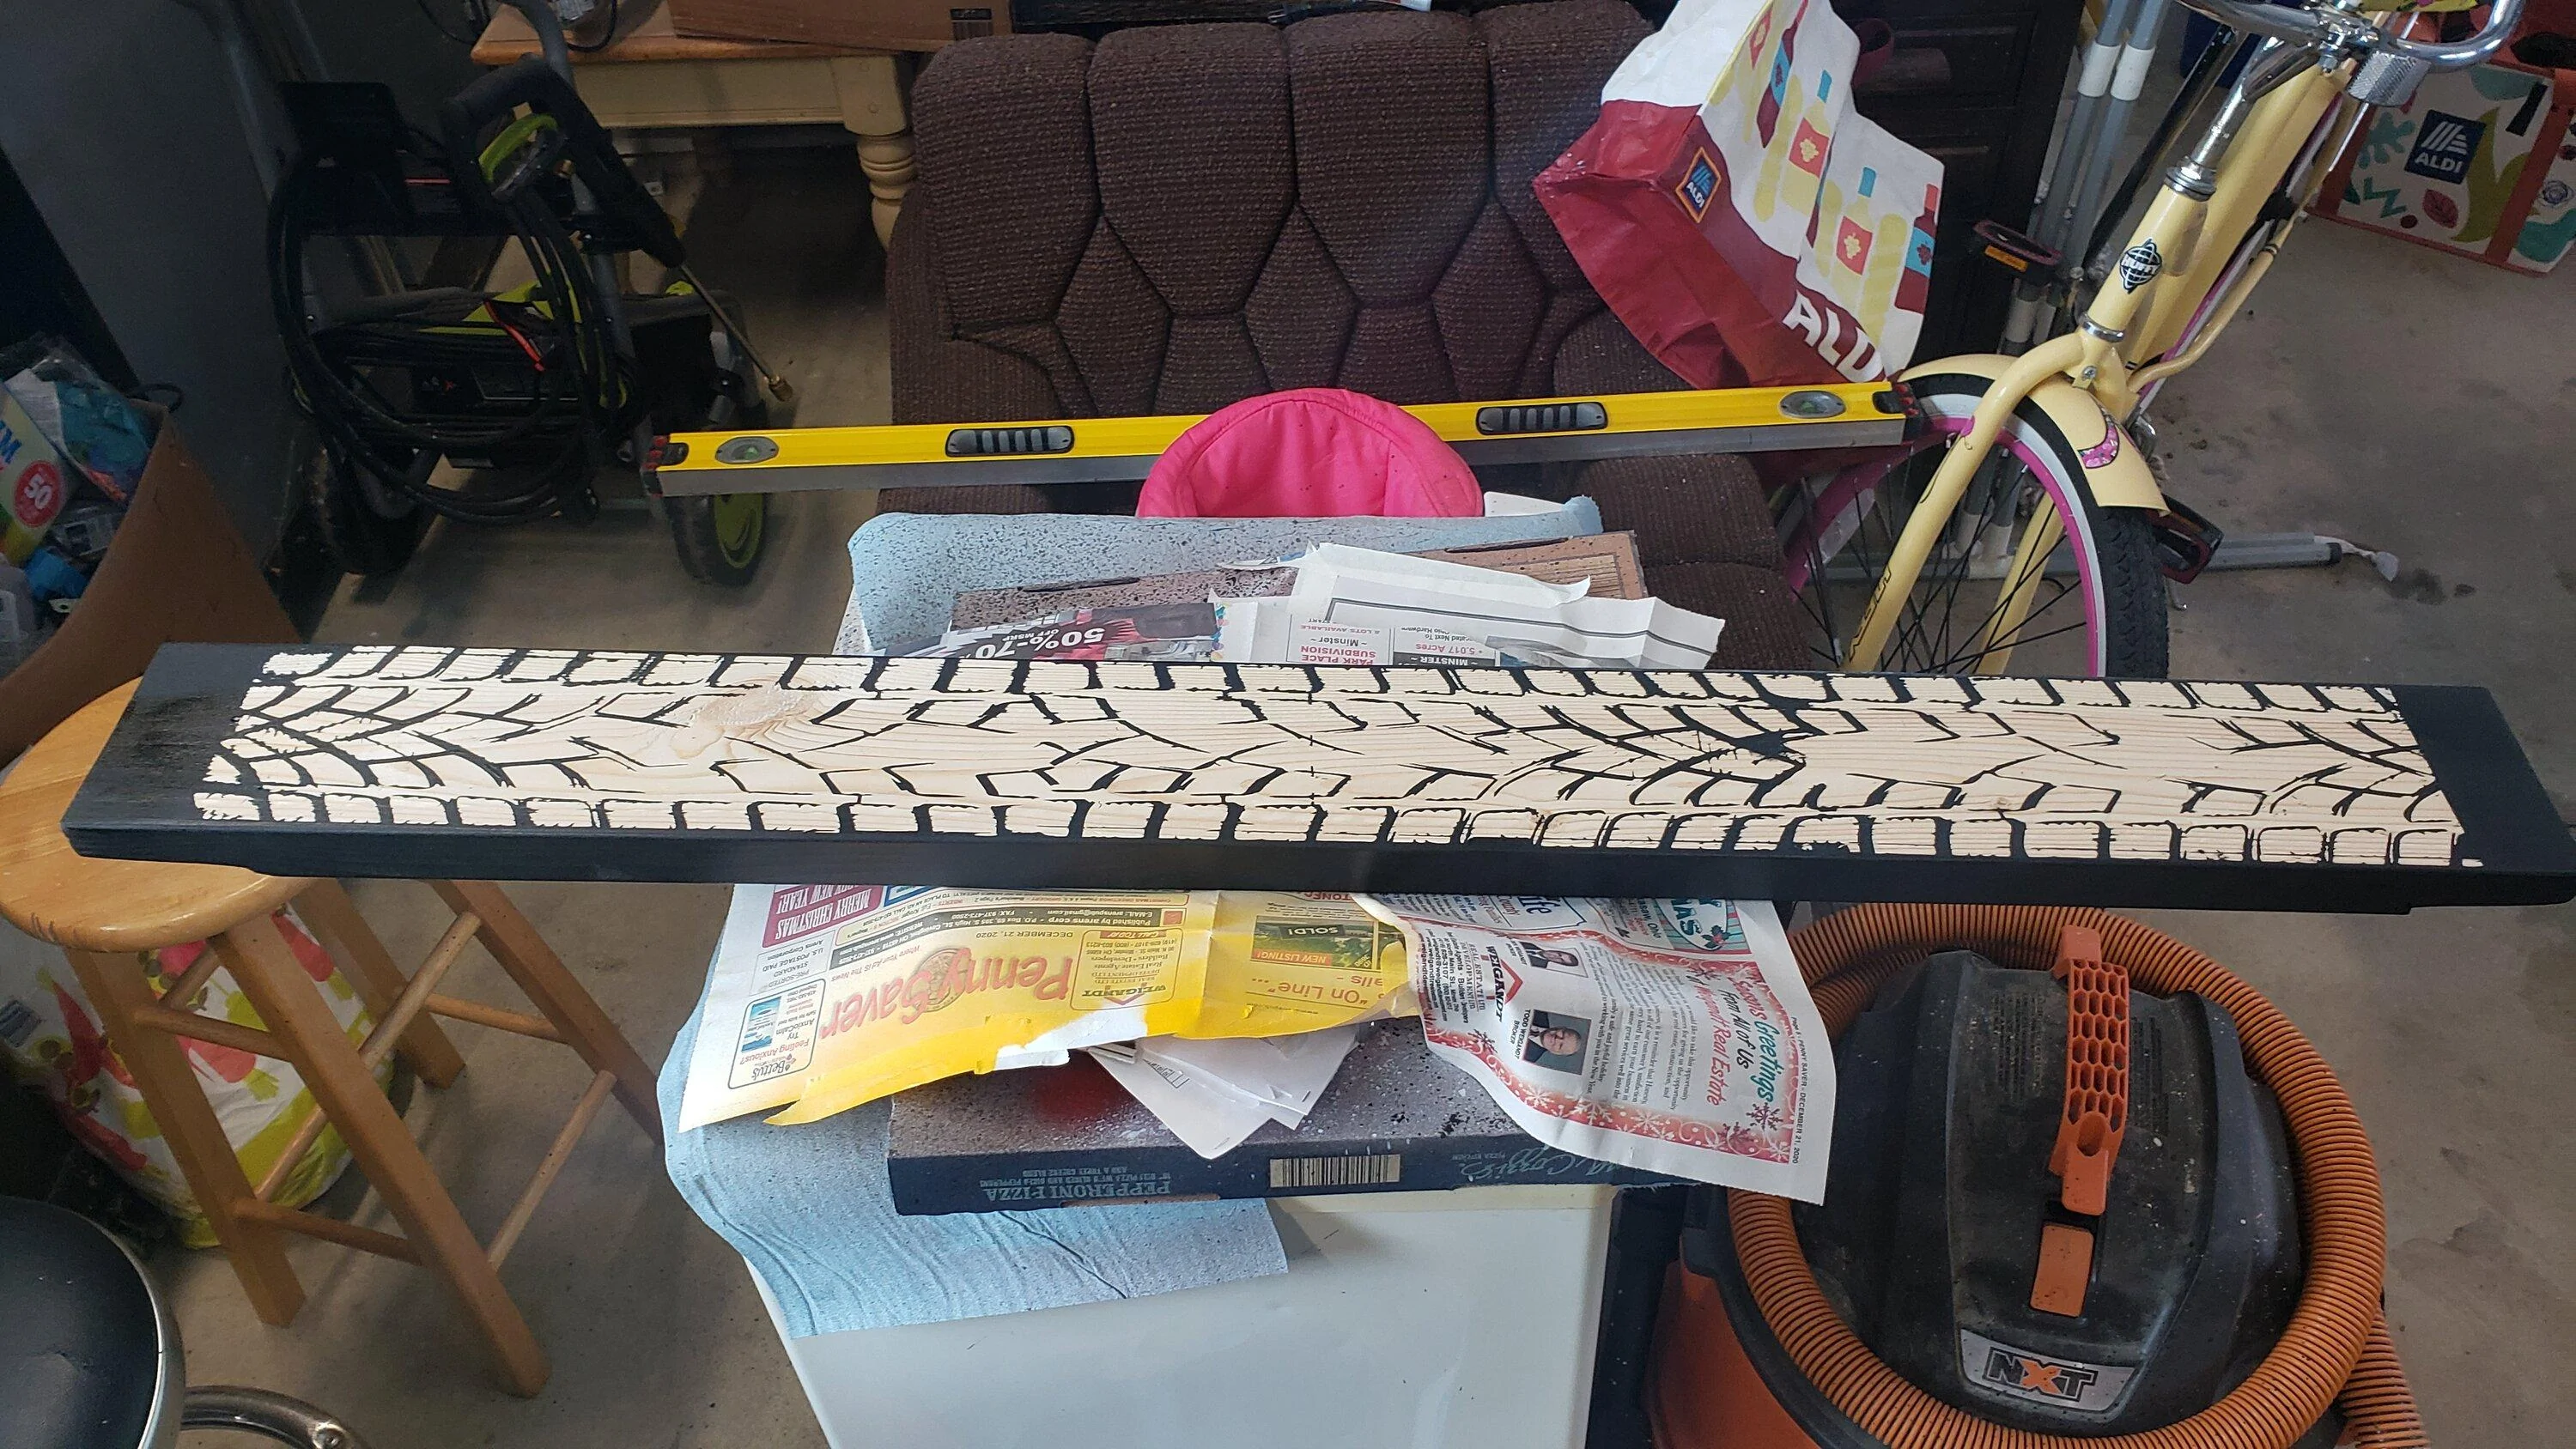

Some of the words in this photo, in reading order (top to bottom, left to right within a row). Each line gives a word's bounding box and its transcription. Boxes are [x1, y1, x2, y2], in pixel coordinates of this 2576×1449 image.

[2415, 151, 2464, 173] ALDI
[1686, 181, 1705, 208] ALDI
[1782, 289, 1884, 382] ALD
[24, 473, 52, 510] 50
[1002, 633, 1035, 642] MSRP
[1042, 628, 1059, 637] OFF
[1301, 625, 1347, 634] AVAILABLE
[961, 627, 1105, 658] 50%-70
[1317, 637, 1359, 647] Minster
[1415, 643, 1445, 652] Acres
[1448, 646, 1475, 655] 5.017
[1301, 646, 1376, 658] SUBDIVISION
[1302, 654, 1335, 663] PLACE
[1339, 658, 1374, 666] PARK
[1420, 656, 1469, 667] MINSTER
[776, 888, 810, 915] YEAR!
[833, 888, 872, 920] MERRY
[775, 902, 834, 940] CHRISTMAS
[1112, 918, 1151, 926] Published
[1288, 927, 1339, 936] SOLD!
[1647, 923, 1662, 939] Ohio
[767, 946, 805, 961] Corporation
[780, 952, 811, 967] POSTAGE
[811, 948, 824, 958] U.S.
[902, 945, 921, 957] Where
[1256, 950, 1302, 963] LISTING!
[1303, 954, 1327, 964] NEW
[1455, 950, 1464, 970] Agents
[1469, 943, 1480, 961] REAL
[762, 962, 778, 973] PAID
[774, 961, 808, 978] STANDARD
[851, 967, 863, 976] The
[871, 960, 882, 968] Ad
[1460, 942, 1472, 998] DEVELOPMENT
[769, 969, 810, 988] PRE-SORTED
[831, 971, 850, 982] News
[939, 947, 1073, 1001] Penny
[1474, 962, 1485, 998] ESTATE
[1082, 985, 1166, 997] WEIGANDT
[1486, 946, 1506, 1022] WEIGANDT
[820, 970, 933, 1040] Saver
[1331, 989, 1368, 1005] "On
[1717, 989, 1741, 1013] From
[1599, 1003, 1607, 1024] working
[1730, 1013, 1752, 1032] All
[776, 1018, 815, 1035] AnxioCalm
[1510, 1020, 1520, 1045] BROKER
[1636, 1019, 1644, 1034] hard
[787, 1032, 799, 1040] Try
[1516, 1028, 1528, 1059] WEIGANDT
[1713, 1025, 1732, 1059] Real
[1736, 1029, 1756, 1050] of
[779, 1039, 810, 1053] Feeling
[1602, 1043, 1611, 1061] joyful
[1620, 1041, 1629, 1064] services
[740, 1048, 778, 1064] Anxious?
[1736, 1048, 1754, 1070] Us
[1750, 1021, 1784, 1102] Greetings
[1590, 1066, 1599, 1079] New
[1598, 1061, 1607, 1082] holiday
[1800, 1062, 1808, 1087] SAVER
[1625, 1070, 1633, 1094] business
[1632, 1071, 1643, 1103] satisfaction
[1680, 1066, 1692, 1100] opportunity
[1706, 1057, 1731, 1106] Estate
[1670, 1076, 1680, 1110] opportunity
[1797, 1092, 1807, 1132] DECEMBER
[1792, 1147, 1801, 1164] 2020
[1116, 1173, 1138, 1182] PIZZA
[982, 1186, 1045, 1202] PIZZA
[1050, 1180, 1171, 1199] PEPPERONI
[1982, 1347, 2099, 1402] NXT
